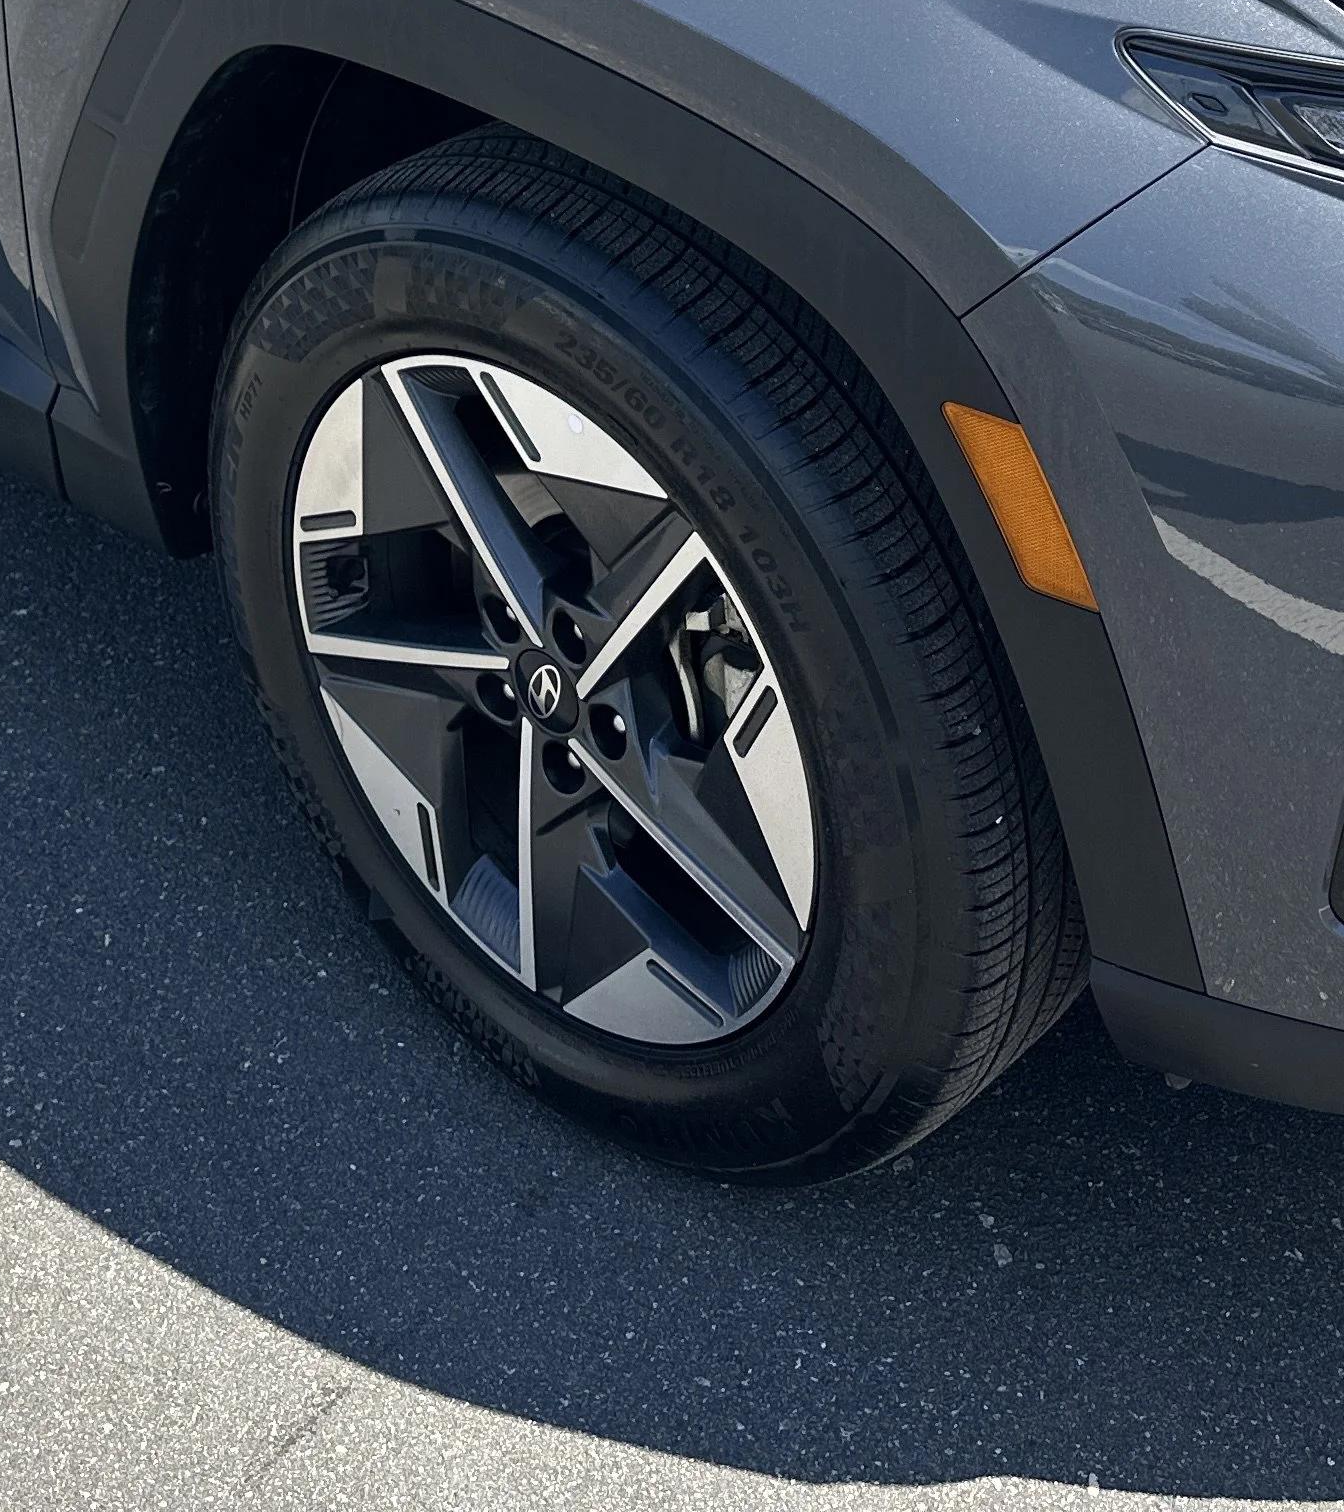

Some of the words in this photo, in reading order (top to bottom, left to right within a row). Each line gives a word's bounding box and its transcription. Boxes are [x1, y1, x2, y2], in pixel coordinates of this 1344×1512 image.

[238, 371, 264, 422] HP71
[555, 330, 667, 431] 235/60
[670, 437, 736, 512] R18
[738, 528, 807, 631] 103H
